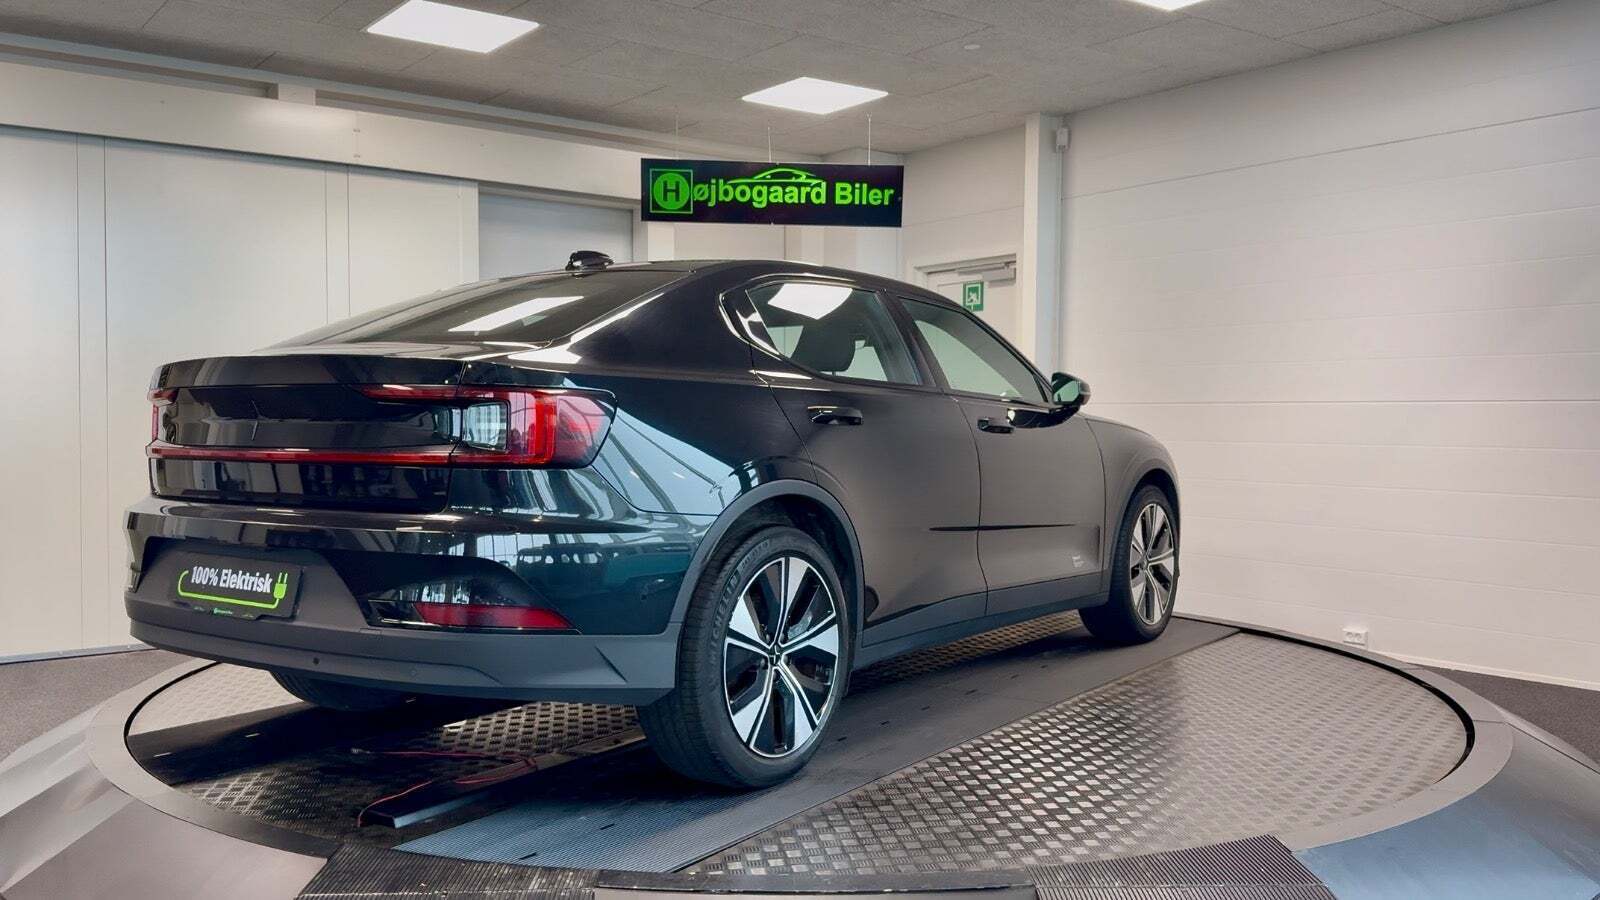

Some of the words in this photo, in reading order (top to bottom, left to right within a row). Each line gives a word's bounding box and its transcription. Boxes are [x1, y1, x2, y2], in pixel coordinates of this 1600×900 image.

[835, 183, 894, 206] Biler
[191, 566, 219, 586] 100%
[220, 568, 273, 593] Elektrisk
